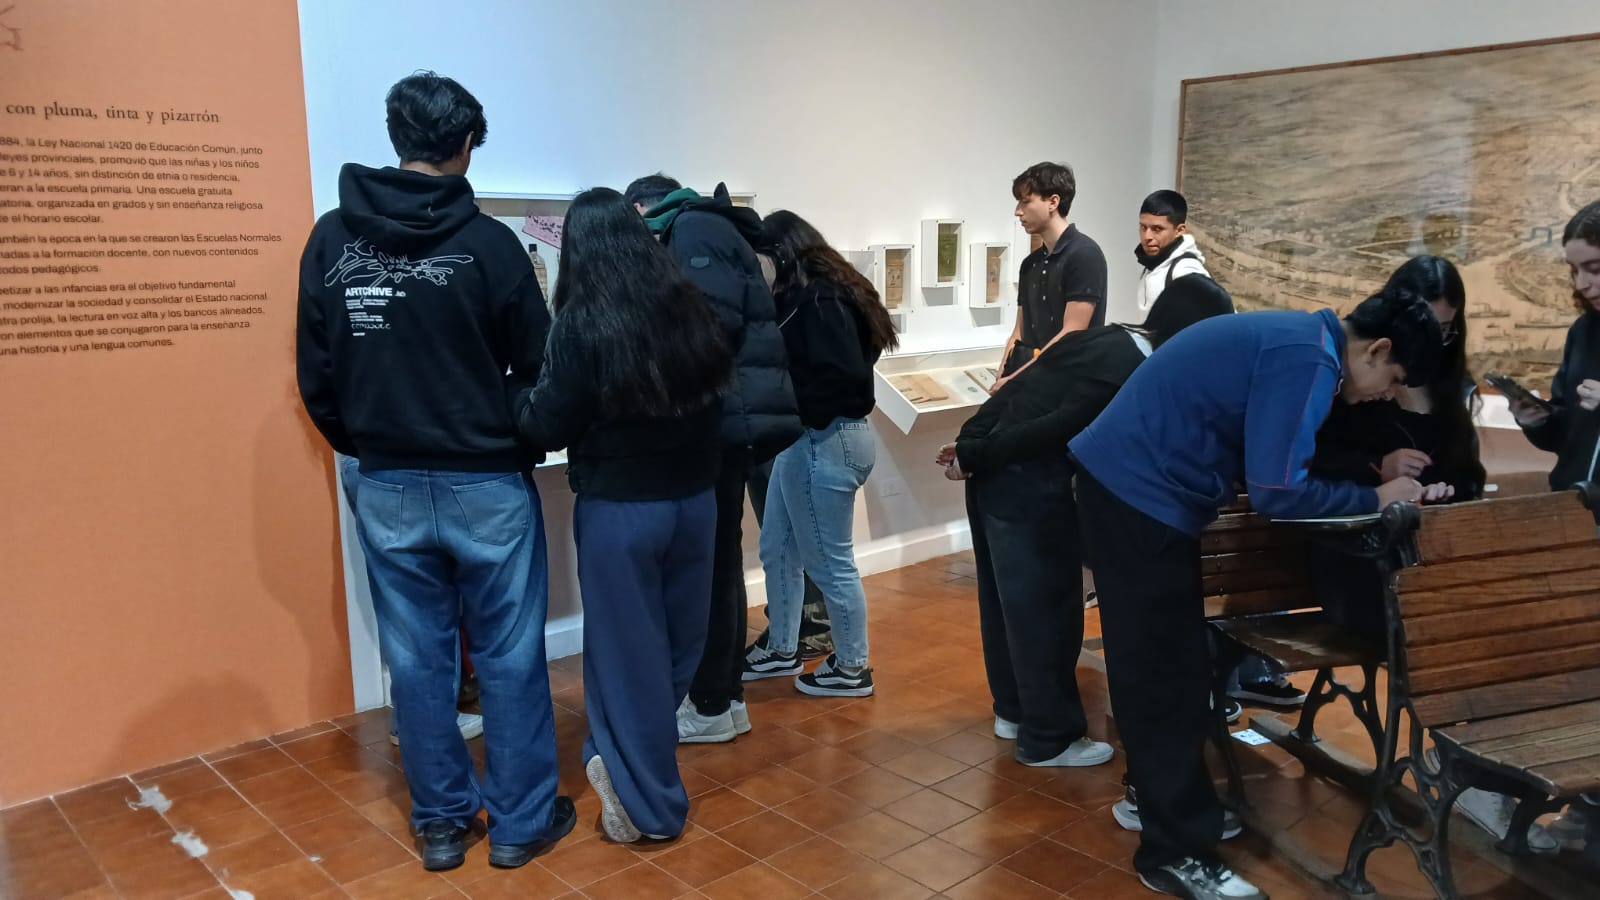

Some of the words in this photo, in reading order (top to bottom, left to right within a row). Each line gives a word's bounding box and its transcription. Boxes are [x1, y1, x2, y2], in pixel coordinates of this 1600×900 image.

[6, 104, 36, 116] con
[44, 101, 98, 120] pluma,
[106, 106, 139, 120] tinta
[160, 108, 220, 126] pizarrón
[38, 138, 58, 149] Ley
[60, 138, 105, 149] Nacional
[109, 141, 132, 150] 1420
[134, 142, 147, 150] de
[149, 141, 200, 152] Educación
[240, 146, 263, 157] junto
[99, 156, 147, 166] promovió
[148, 158, 167, 168] que
[169, 156, 183, 166] las
[185, 157, 210, 167] niñas
[219, 160, 233, 168] los
[235, 160, 260, 168] niños
[74, 169, 90, 178] sin
[92, 170, 140, 180] distinción
[142, 172, 154, 180] de
[48, 184, 88, 193] escuela
[136, 185, 157, 194] Una
[158, 186, 196, 195] escuela
[198, 187, 233, 197] gratuita
[36, 200, 95, 210] organizada
[112, 200, 146, 210] grados
[157, 200, 170, 208] sin
[172, 200, 224, 209] enseñanza
[226, 200, 264, 211] religiosa
[24, 214, 61, 223] horario
[50, 234, 81, 244] época
[108, 235, 128, 244] que
[181, 233, 195, 242] las
[196, 233, 238, 242] Escuelas
[239, 233, 282, 242] Normales
[54, 248, 105, 258] formación
[172, 248, 206, 256] nuevos
[208, 248, 258, 256] contenidos
[44, 285, 59, 294] las
[62, 284, 108, 293] infancias
[138, 281, 176, 292] objetivo
[178, 280, 236, 289] fundamental
[345, 287, 393, 297] ARTCHIVE
[3, 300, 64, 310] modernizar
[78, 298, 124, 307] sociedad
[133, 295, 183, 304] consolidar
[196, 294, 228, 303] Estado
[70, 312, 104, 322] lectura
[120, 312, 138, 320] voz
[140, 310, 158, 319] alta
[168, 309, 182, 318] los
[184, 308, 218, 317] bancos
[16, 329, 72, 339] elementos
[74, 328, 94, 338] que
[96, 327, 108, 336] se
[110, 324, 166, 336] conjugaron
[168, 322, 189, 333] para
[20, 344, 59, 354] historia
[70, 344, 88, 352] una
[92, 341, 125, 352] lengua
